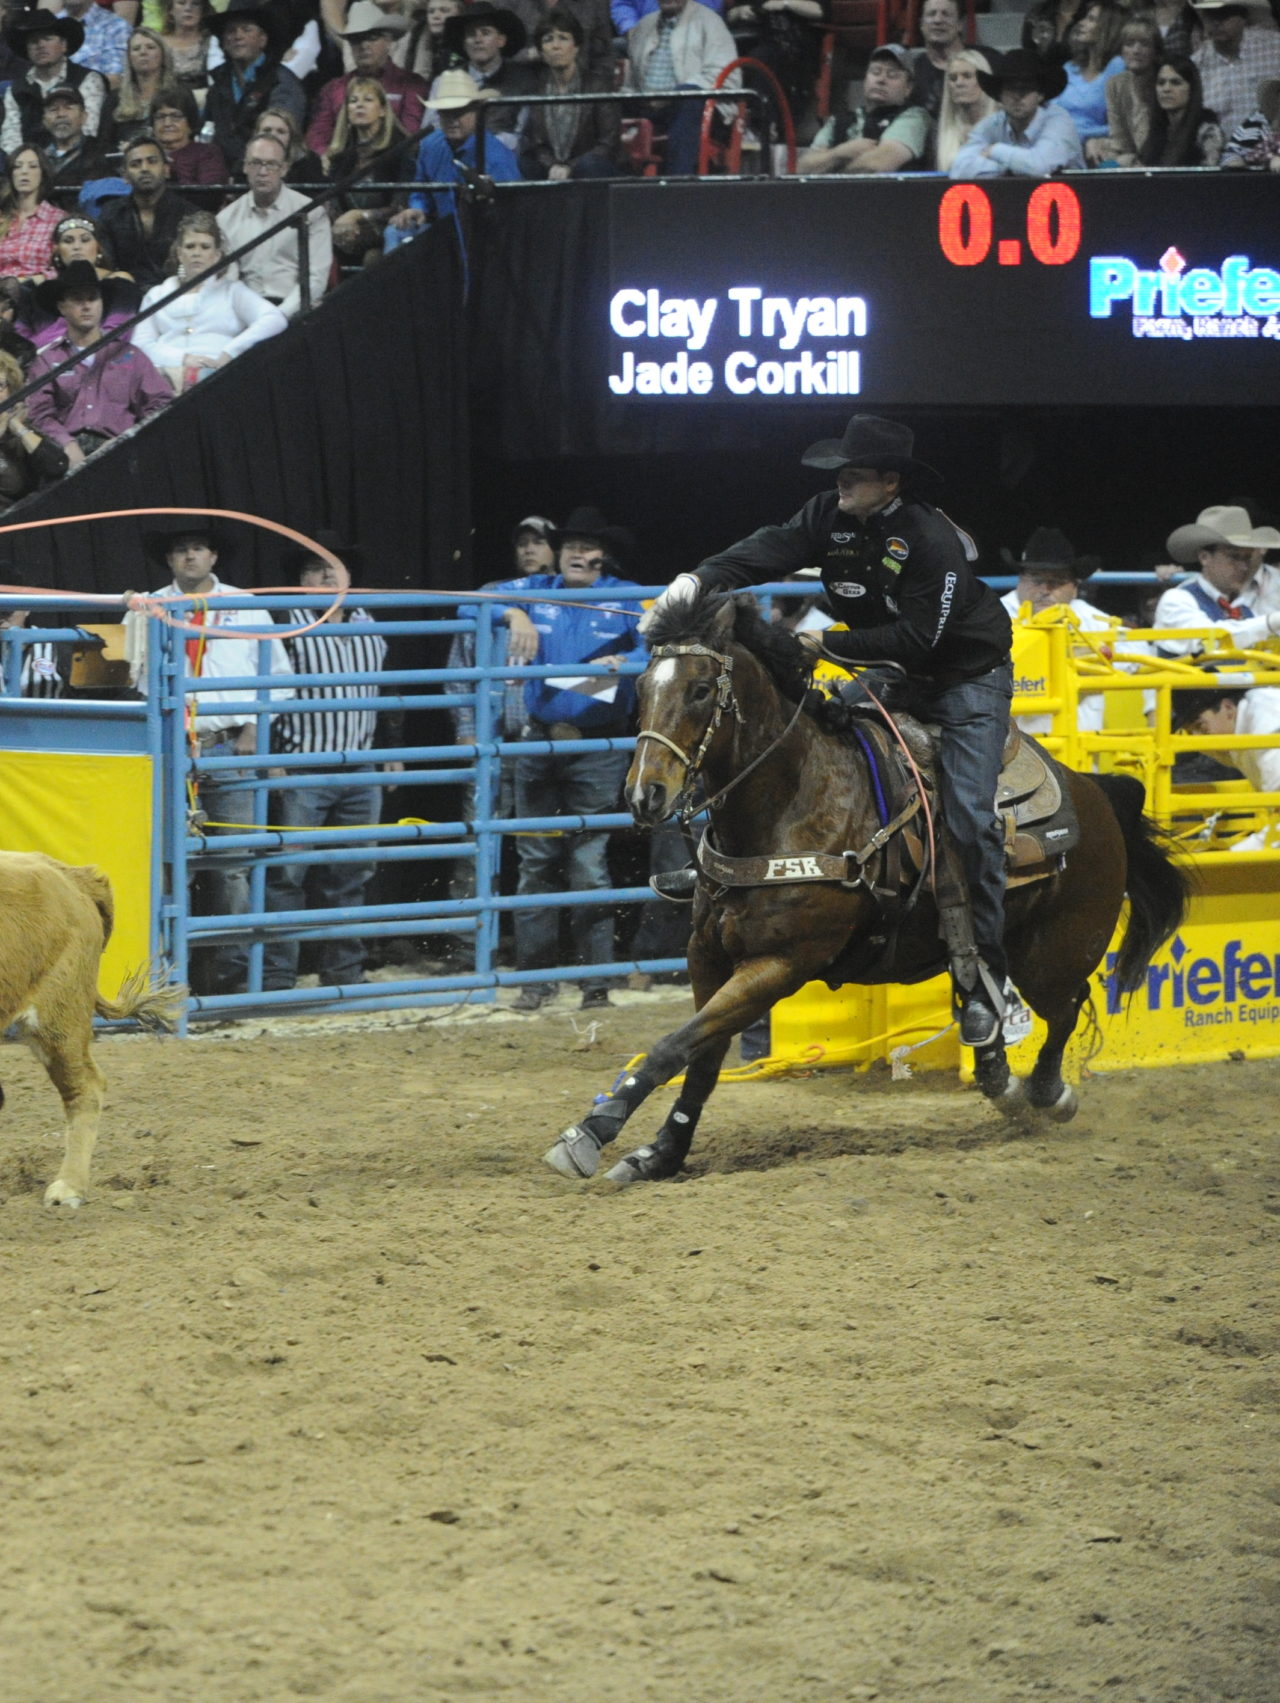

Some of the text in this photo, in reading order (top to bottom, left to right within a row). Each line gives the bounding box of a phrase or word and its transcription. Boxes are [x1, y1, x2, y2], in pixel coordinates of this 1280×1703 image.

[939, 182, 1081, 266] 0.0
[1089, 247, 1280, 318] Priefe
[610, 287, 867, 350] Clay Tryan
[608, 351, 861, 394] Jade Corkill
[1106, 934, 1280, 1015] Priefe
[1185, 1006, 1234, 1028] Ranch
